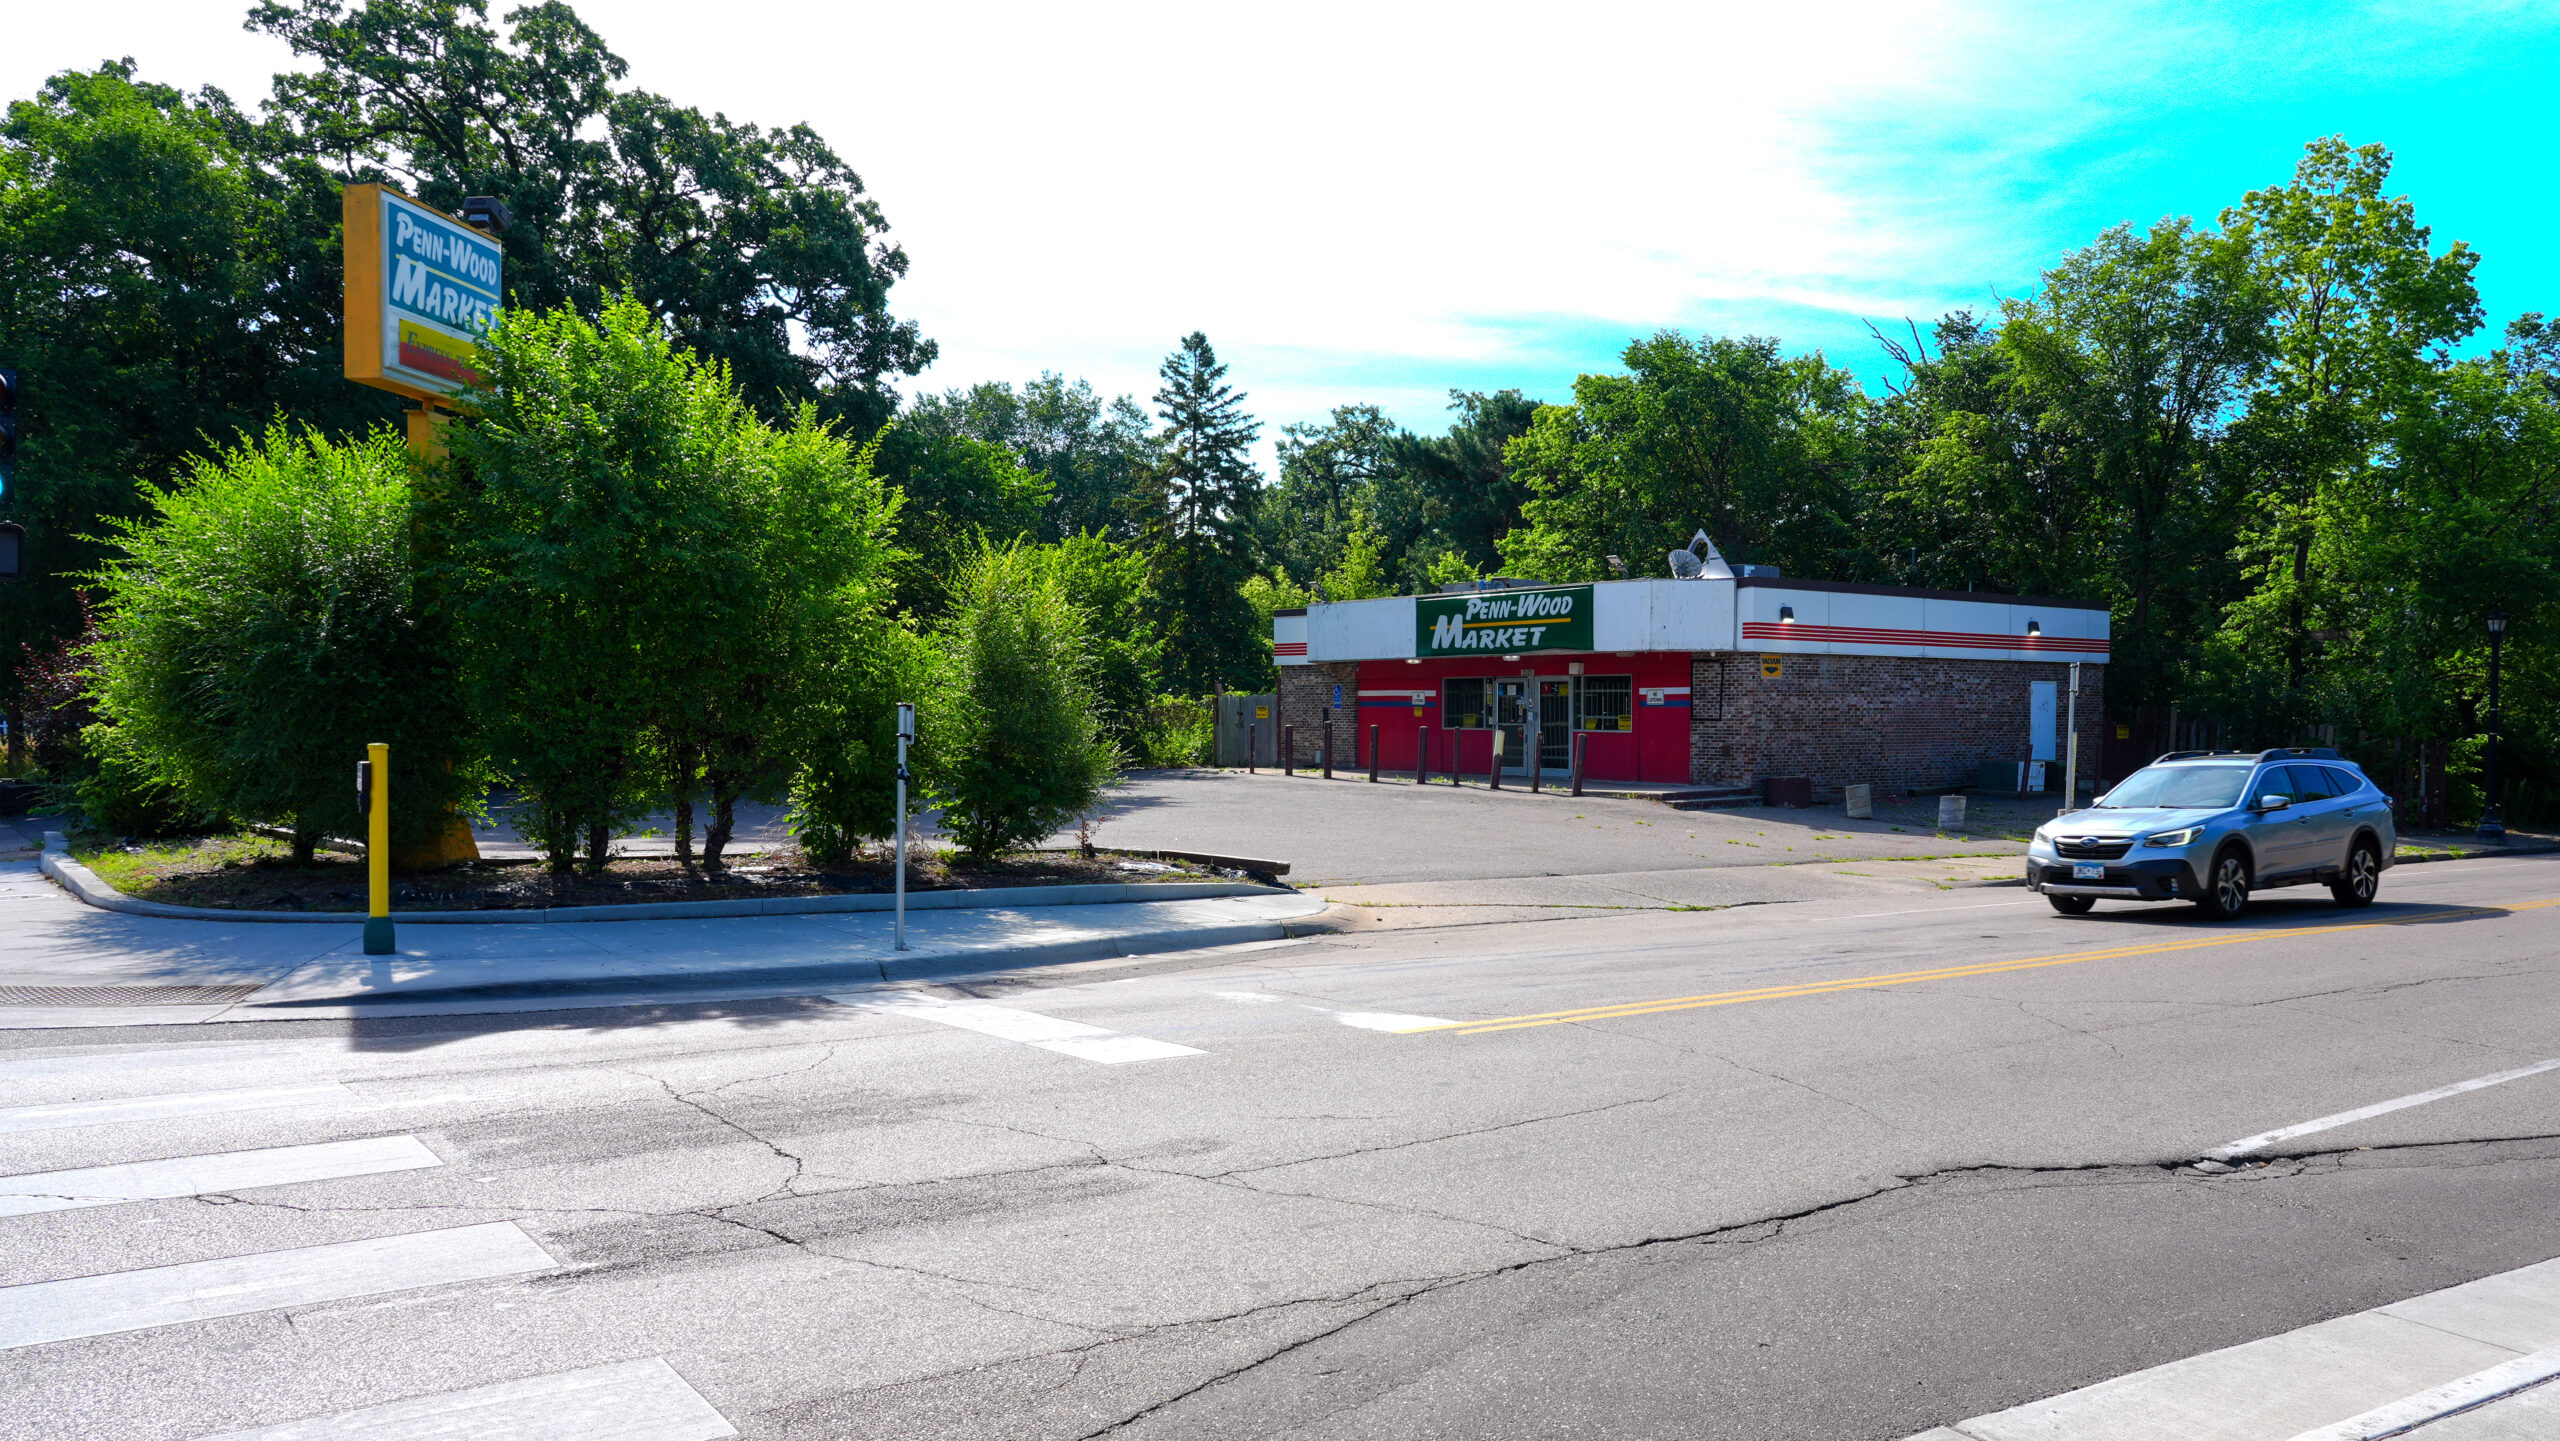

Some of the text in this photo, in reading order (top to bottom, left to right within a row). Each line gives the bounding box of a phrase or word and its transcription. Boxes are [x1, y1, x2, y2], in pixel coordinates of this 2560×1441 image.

[396, 211, 497, 286] PENN-WOOD
[1465, 594, 1573, 621] PENN-WOOD
[1431, 613, 1546, 649] MARKET
